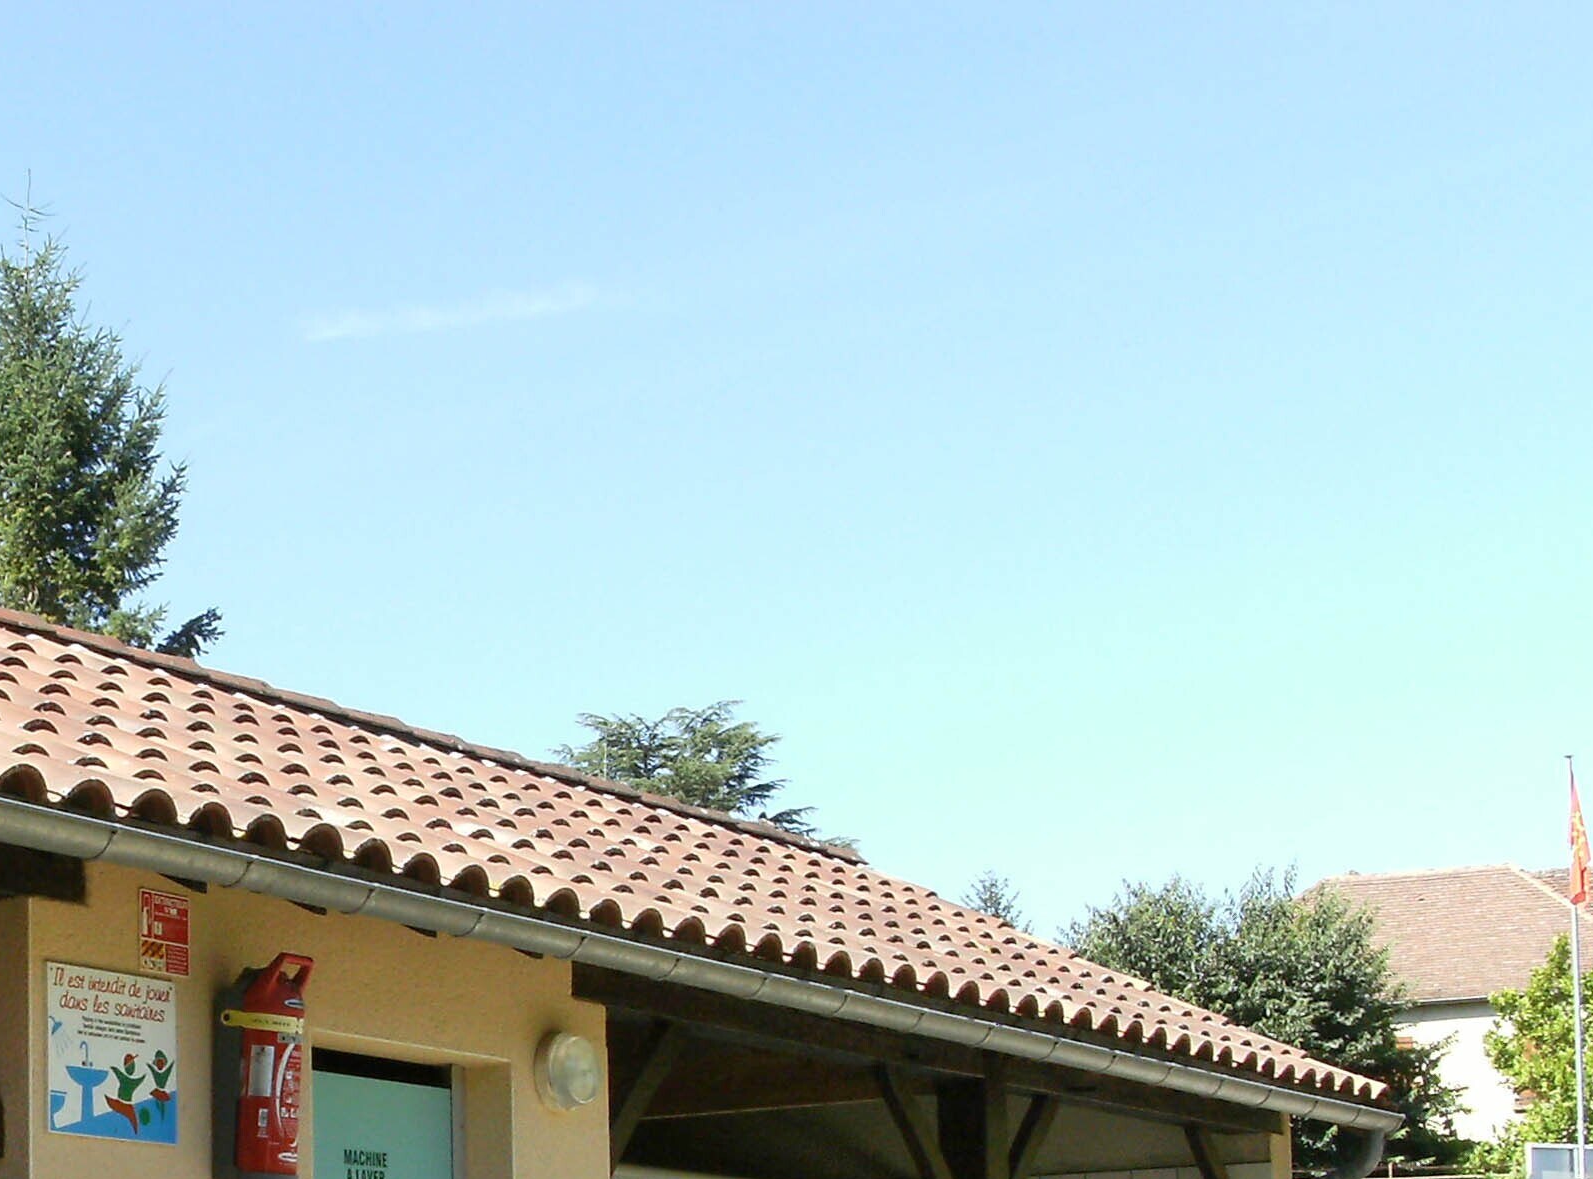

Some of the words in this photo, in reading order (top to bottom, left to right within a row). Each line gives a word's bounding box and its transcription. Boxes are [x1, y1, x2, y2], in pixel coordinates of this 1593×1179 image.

[53, 967, 64, 986] Il
[67, 975, 85, 989] est
[88, 976, 126, 995] interdit
[129, 981, 142, 998] de
[142, 985, 171, 1004] jouer
[60, 991, 88, 1011] dans
[93, 994, 110, 1014] les
[114, 1003, 166, 1023] sanitaires
[343, 1148, 388, 1169] MACHINE
